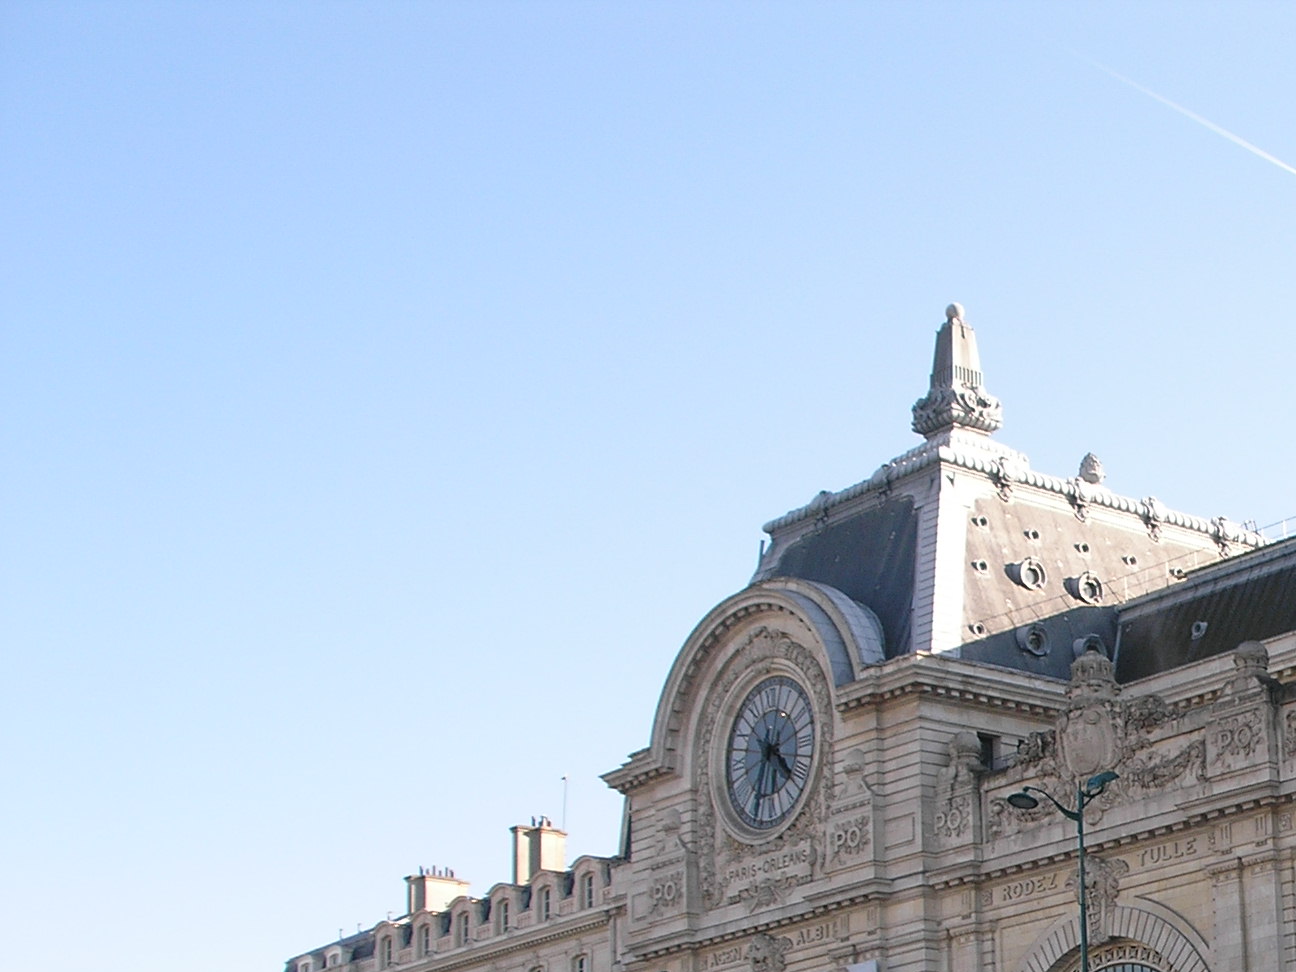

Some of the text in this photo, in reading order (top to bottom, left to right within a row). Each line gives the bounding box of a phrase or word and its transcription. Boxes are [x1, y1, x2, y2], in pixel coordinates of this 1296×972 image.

[1136, 837, 1197, 868] TULLE
[1003, 872, 1058, 901] RODEZ
[797, 923, 831, 946] ALBI
